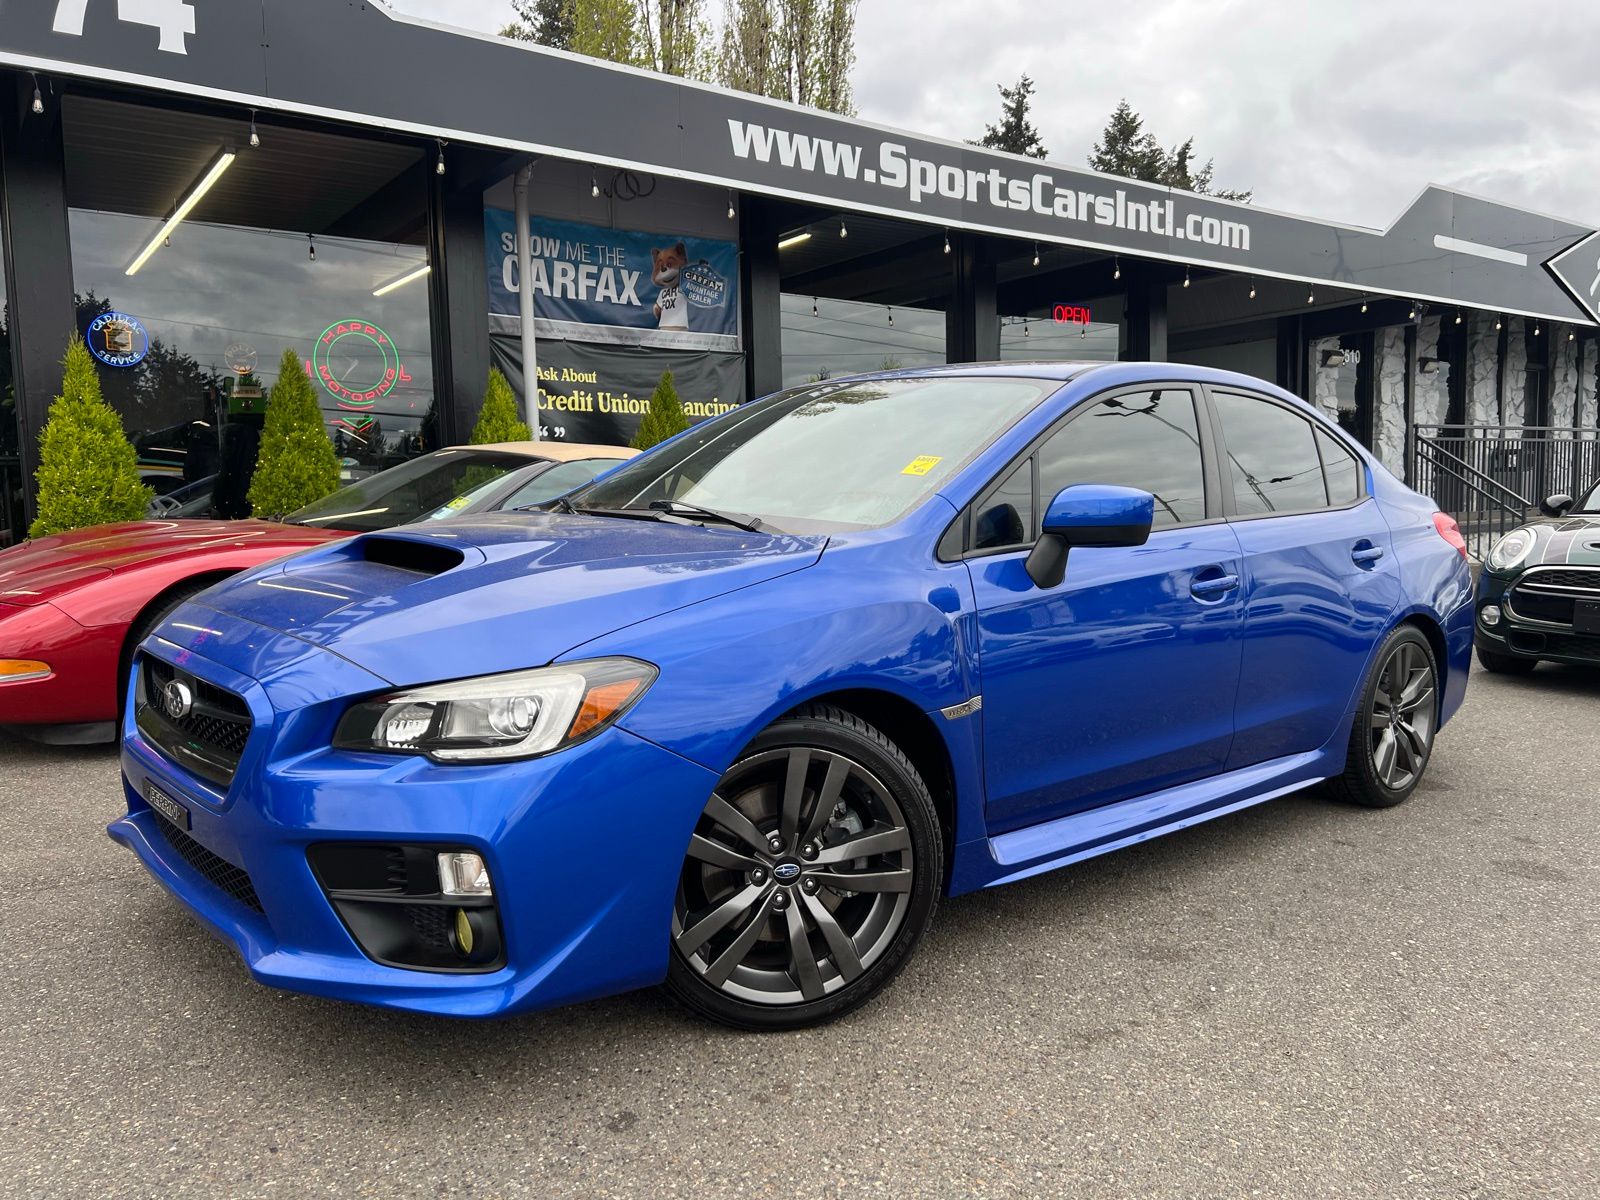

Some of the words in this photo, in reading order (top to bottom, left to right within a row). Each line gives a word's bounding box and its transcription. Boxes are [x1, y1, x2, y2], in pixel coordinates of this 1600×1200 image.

[727, 118, 1250, 251] www.SportsCarsIntl.com
[502, 232, 560, 258] SOW
[566, 241, 592, 263] ME
[594, 245, 625, 267] THE
[502, 254, 642, 306] CARFAX
[684, 272, 724, 292] CARFAX
[662, 288, 678, 300] CAR
[686, 282, 719, 299] ADVANTAGE
[688, 291, 712, 305] DEALER
[661, 298, 676, 310] FOX
[92, 313, 143, 335] CADILLAC
[1054, 305, 1090, 325] OPEN
[322, 322, 388, 345] HAPPY
[97, 350, 141, 365] SERVICE
[319, 365, 396, 402] MOTORING
[536, 366, 559, 381] Ask
[561, 368, 598, 384] About
[536, 388, 594, 412] Credit
[597, 392, 652, 415] Union
